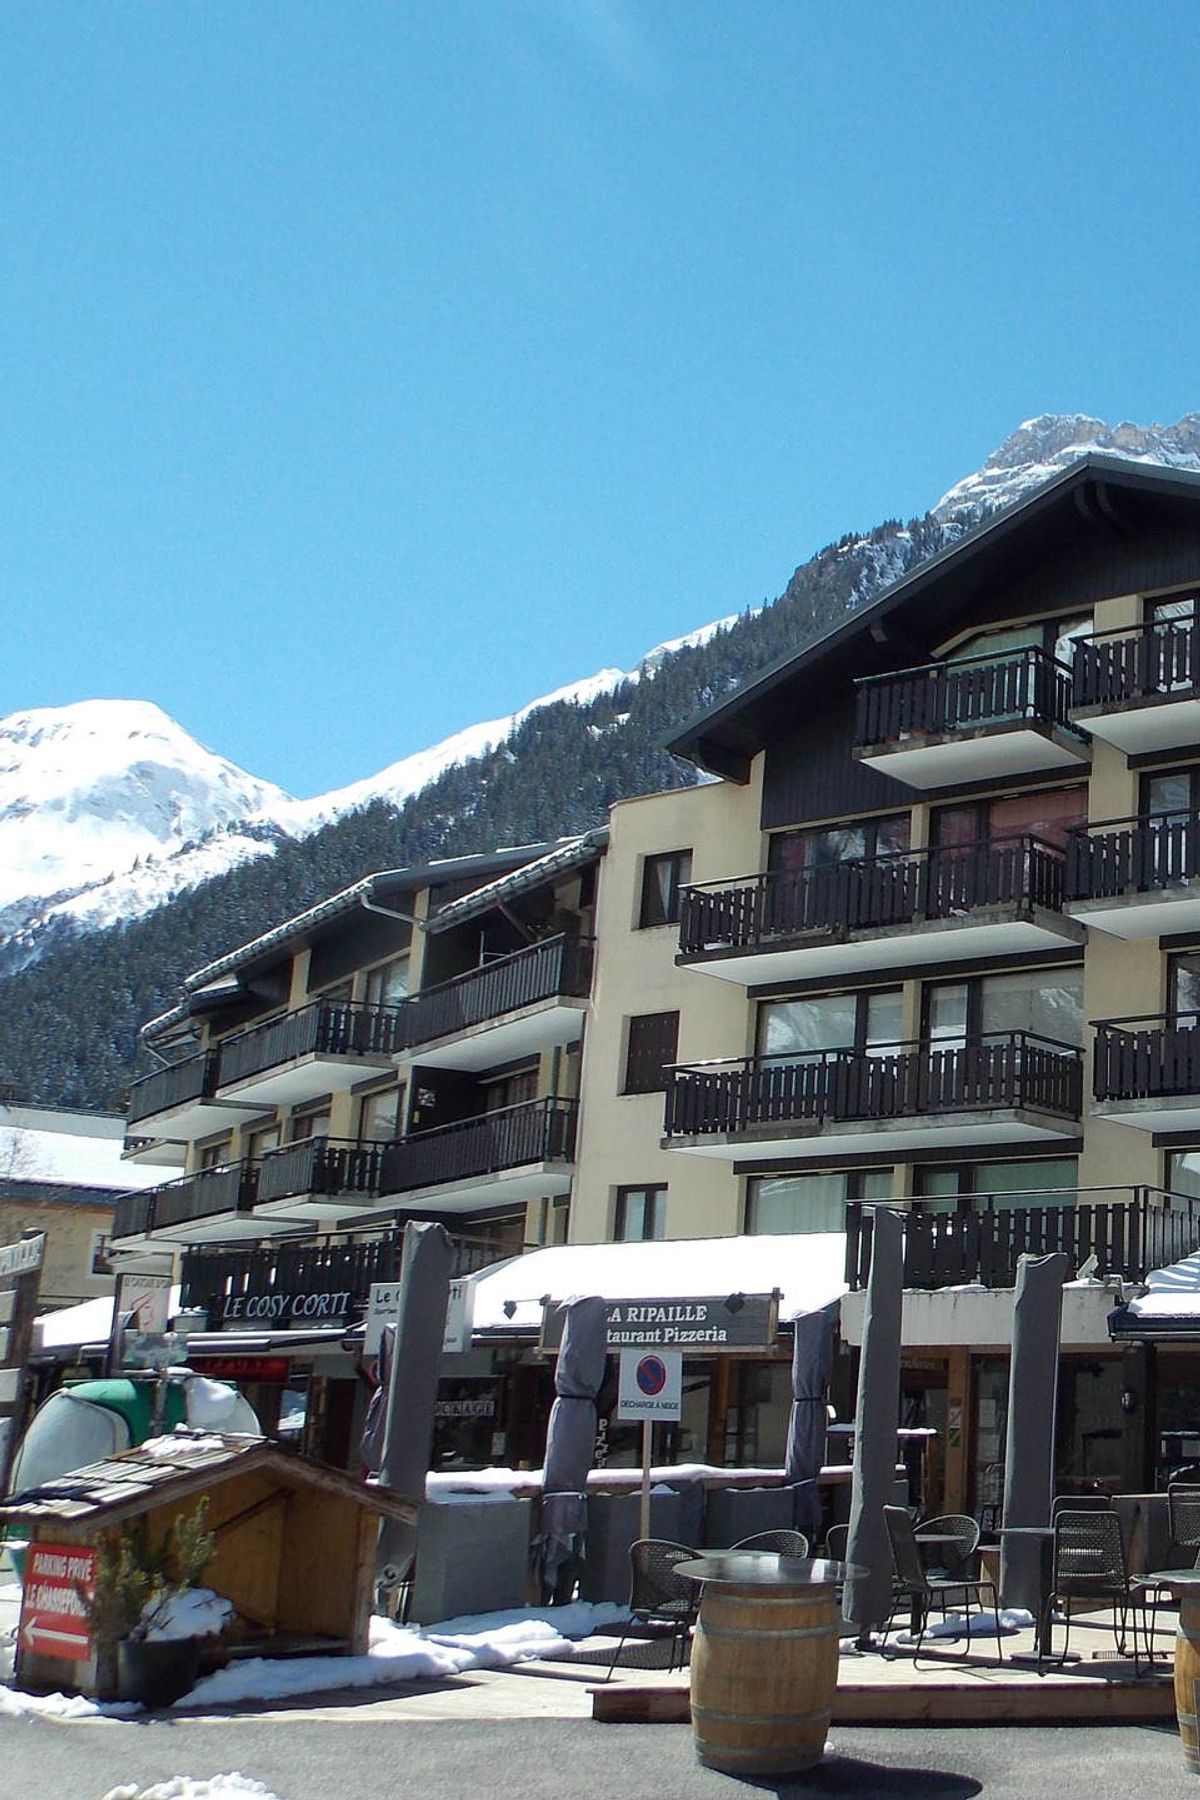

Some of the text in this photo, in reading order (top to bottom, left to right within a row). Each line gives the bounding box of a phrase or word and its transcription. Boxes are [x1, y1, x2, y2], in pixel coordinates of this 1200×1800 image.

[223, 1291, 350, 1318] LE COSY CORTI
[376, 1289, 391, 1304] Le
[626, 1305, 708, 1322] RIPAILLE
[663, 1325, 728, 1342] Pizzeria
